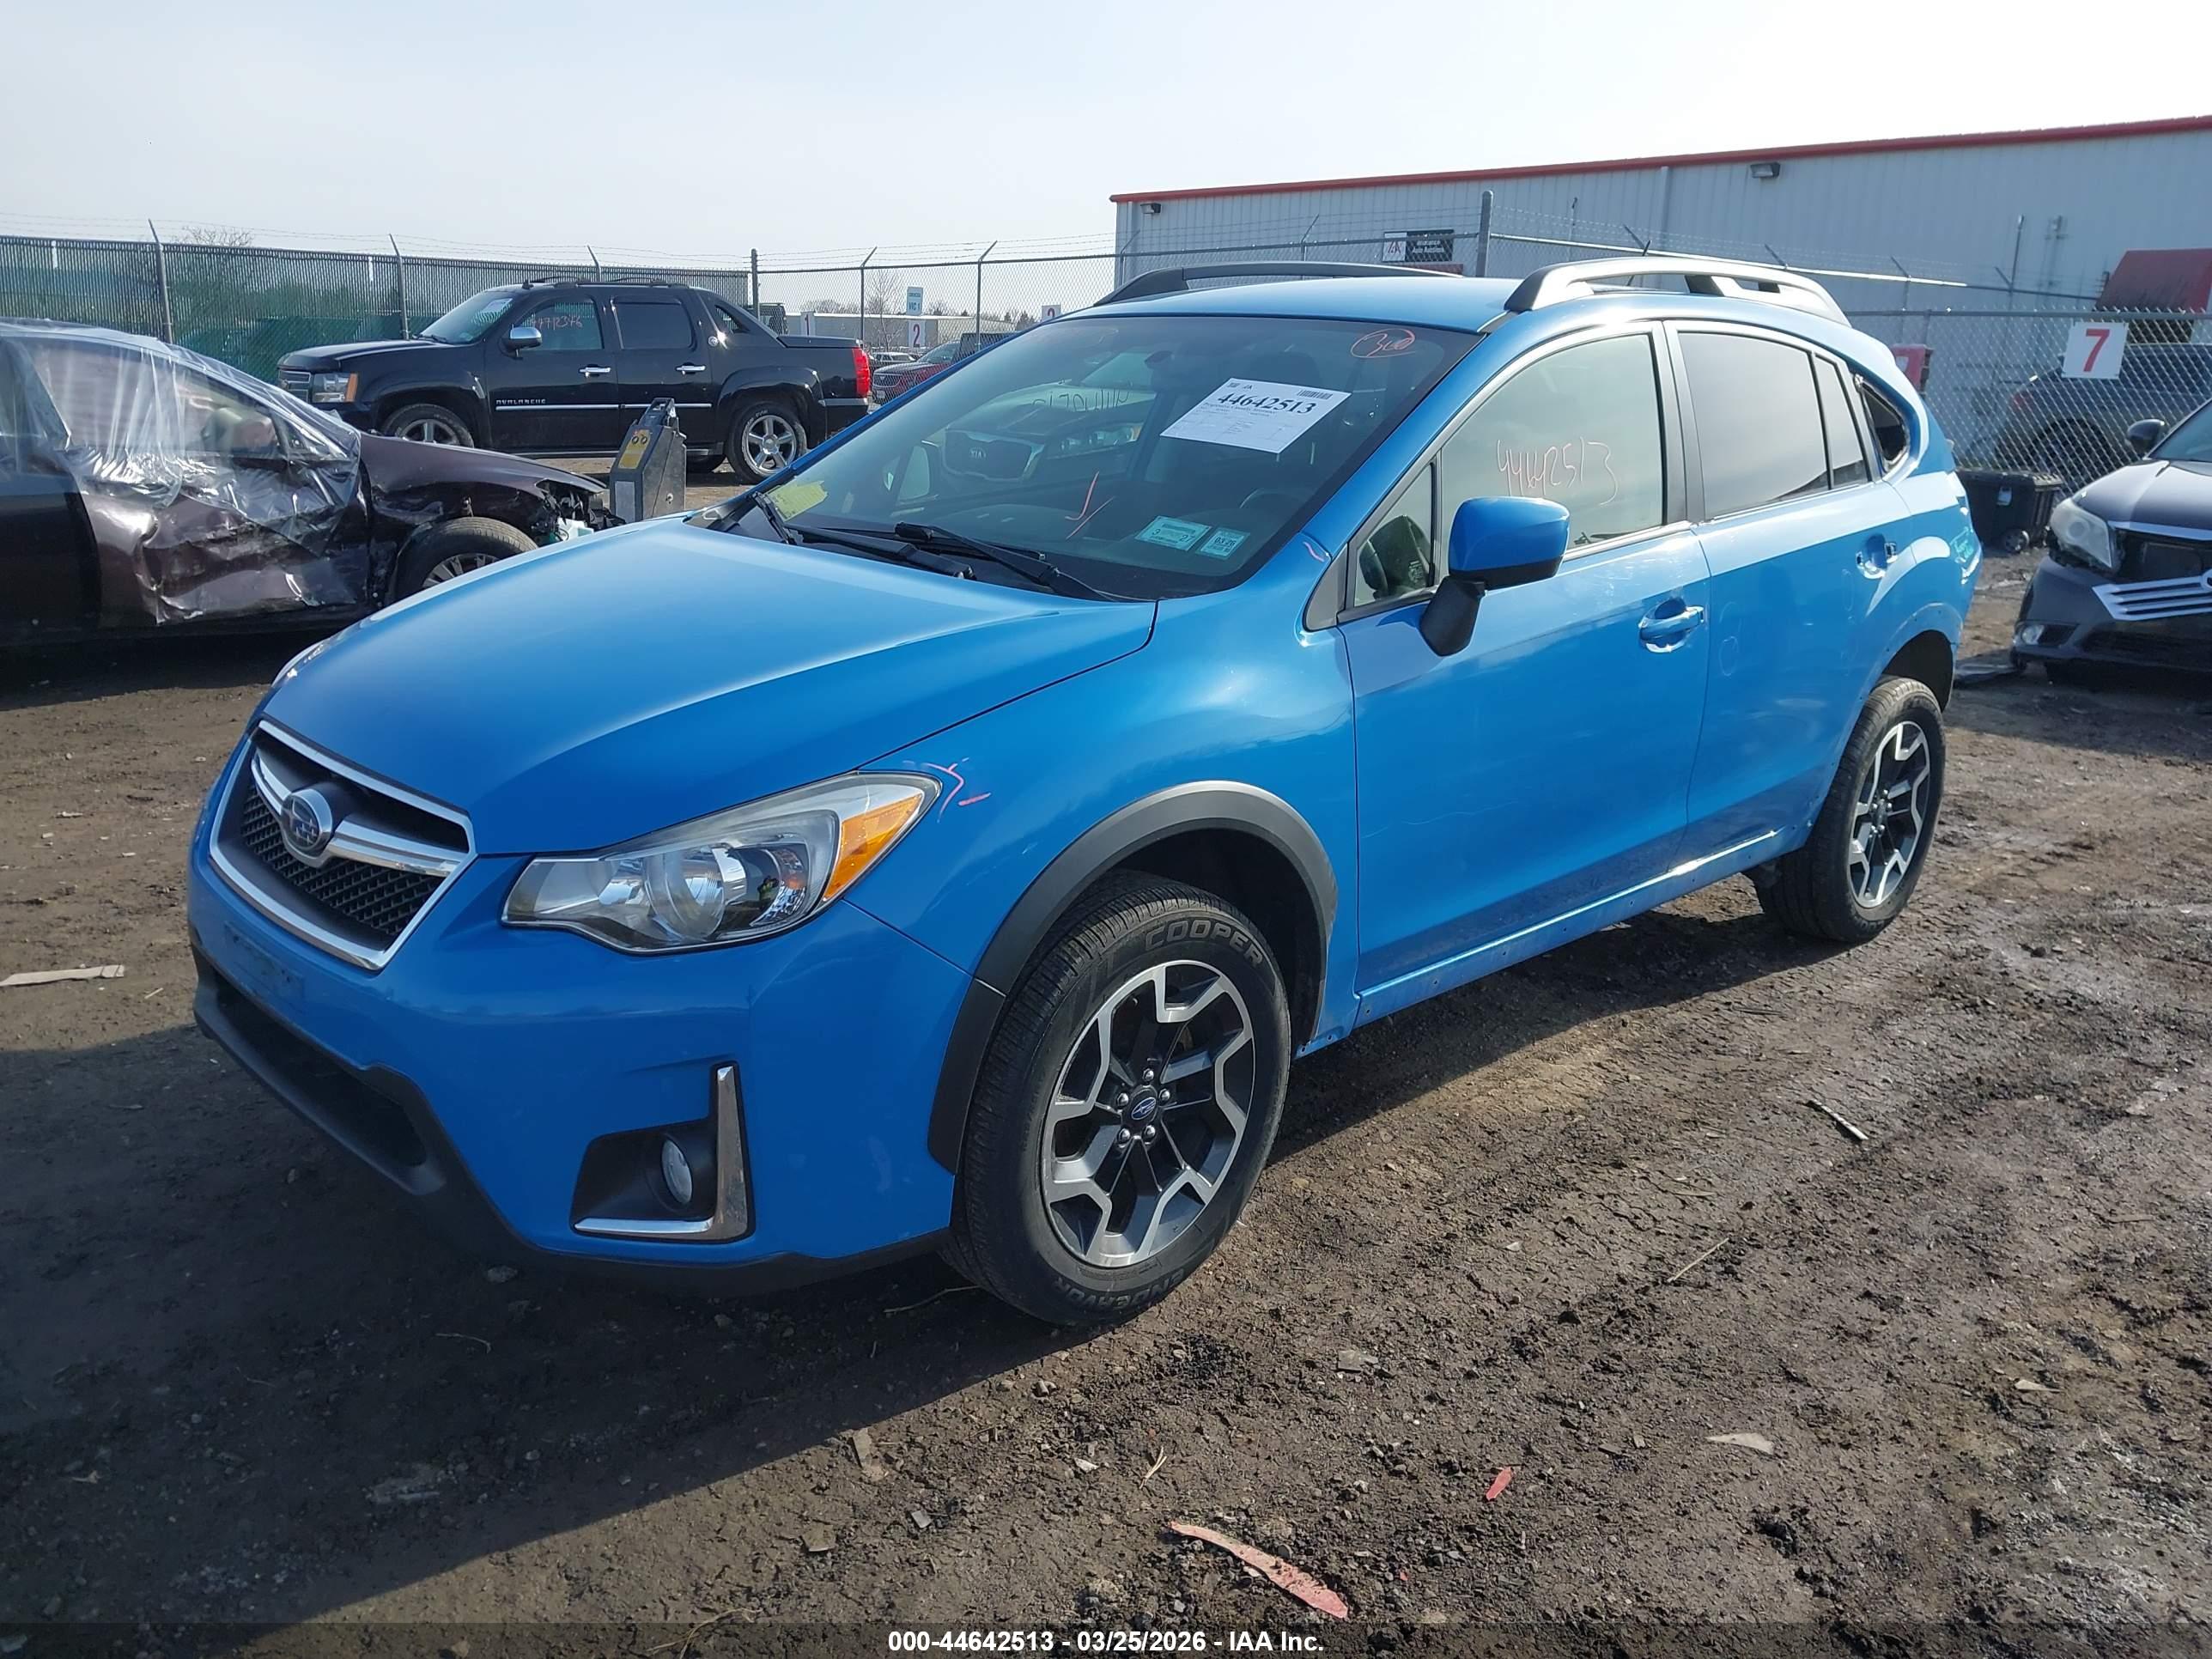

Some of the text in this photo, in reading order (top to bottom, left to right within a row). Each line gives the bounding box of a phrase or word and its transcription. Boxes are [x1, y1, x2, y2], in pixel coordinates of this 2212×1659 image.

[913, 323, 921, 348] 2
[2083, 328, 2111, 373] 7
[1218, 392, 1316, 414] 44642513
[1145, 920, 1263, 967] COOPER
